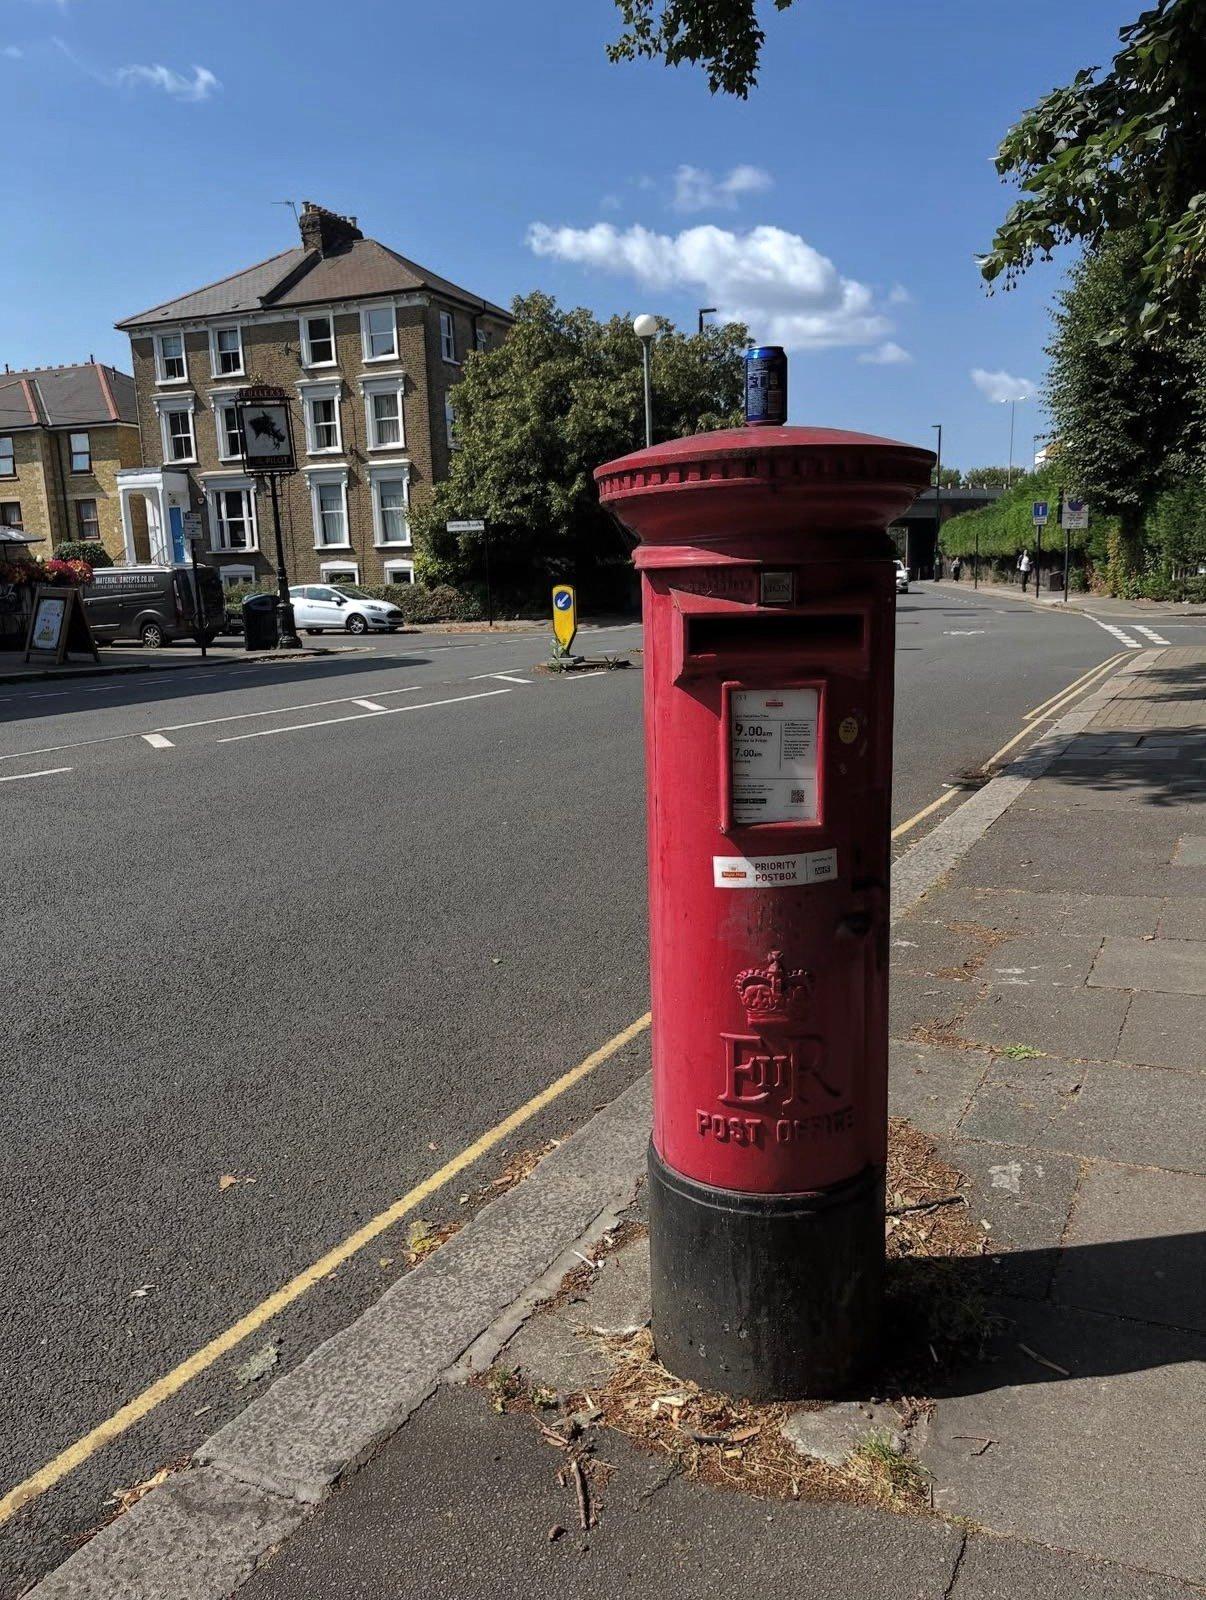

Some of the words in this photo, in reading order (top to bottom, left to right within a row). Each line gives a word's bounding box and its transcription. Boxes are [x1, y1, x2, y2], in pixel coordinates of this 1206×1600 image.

[763, 583, 792, 593] MON
[735, 722, 773, 737] 9.00am
[735, 748, 763, 757] 7.00am
[755, 860, 797, 871] PRIORITY
[815, 866, 830, 875] NHS
[755, 872, 797, 882] POSTBOX
[695, 1107, 764, 1146] POST
